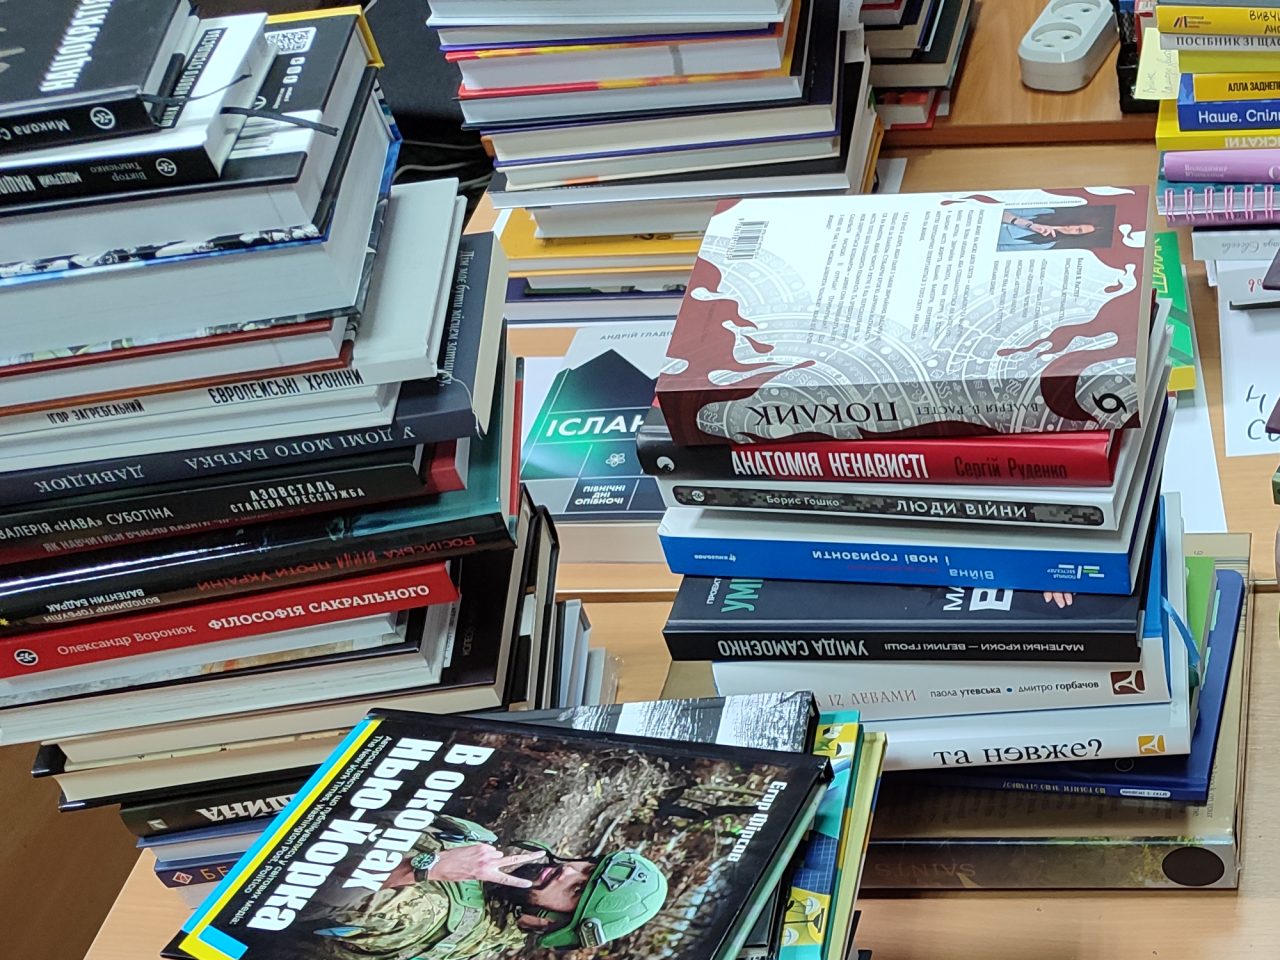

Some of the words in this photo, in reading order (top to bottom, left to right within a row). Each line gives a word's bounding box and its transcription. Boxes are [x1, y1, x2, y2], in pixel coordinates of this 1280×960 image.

[1175, 36, 1242, 48] ПОСІБНИК
[1243, 37, 1255, 47] ЗІ
[1227, 80, 1250, 93] АЛЛА
[28, 118, 70, 135] Микола
[1197, 109, 1244, 125] Наше.
[747, 401, 898, 428] ПОКЛИК
[343, 427, 395, 450] ДОМІ
[401, 425, 416, 440] У
[276, 438, 335, 459] МОГО
[184, 448, 269, 472] БАТЬКА
[731, 449, 821, 478] АНАТОМІЯ
[828, 451, 930, 479] НЕНАВИСТІ
[953, 456, 1000, 480] Сергій
[1007, 458, 1068, 481] Руденко
[33, 463, 145, 493] ДАВИДЮК
[249, 480, 336, 501] АЗОВСТАЛЬ
[582, 484, 626, 493] ПІВНІЧНІ
[592, 491, 612, 499] ДНІ
[229, 498, 283, 514] СТАЛЕВА
[287, 493, 366, 508] ПРЕССЛУЖБА
[574, 497, 625, 506] ОПІВНОЧІ
[765, 493, 803, 507] Борис
[804, 495, 841, 509] Гошко
[896, 499, 958, 517] ЛЮДИ
[964, 501, 1028, 519] ВІЙНИ
[105, 504, 175, 529] СУБОТІНА
[811, 549, 899, 565] горизонти
[904, 554, 939, 566] нові
[274, 561, 332, 580] ПРОТИ
[948, 567, 995, 581] Війна
[45, 597, 91, 613] БАДРАК
[88, 588, 146, 606] ВАЛЕНТИН
[95, 595, 161, 614] ВОЛОДИМИР
[57, 631, 132, 657] Олександр
[132, 622, 196, 645] Воронюк
[207, 605, 306, 631] ФІЛОСОФІЯ
[308, 584, 430, 613] САКРАЛЬНОГО
[717, 637, 810, 658] САМОЄНКО
[810, 637, 869, 657] УМІДА
[883, 640, 922, 653] ГРОШІ
[923, 641, 966, 653] ВЕЛИКІ
[979, 642, 1022, 654] КРОКИ
[1023, 642, 1085, 654] МАЛЕНЬКІ
[930, 688, 959, 699] паола
[959, 686, 1002, 699] утевська
[1018, 683, 1055, 695] дмитро
[1055, 680, 1100, 693] горбачов
[371, 735, 384, 748] The
[355, 747, 372, 764] New
[363, 736, 392, 770] Авторські
[445, 743, 496, 767] В
[933, 749, 973, 766] та
[321, 776, 346, 804] Times,
[755, 781, 788, 812] Єгор
[285, 803, 326, 847] Washington
[287, 806, 331, 860] публікувались
[342, 770, 466, 893] окопах
[727, 812, 769, 863] Фірсов
[267, 845, 289, 866] Post,
[244, 866, 273, 894] Politico
[255, 866, 283, 901] світових
